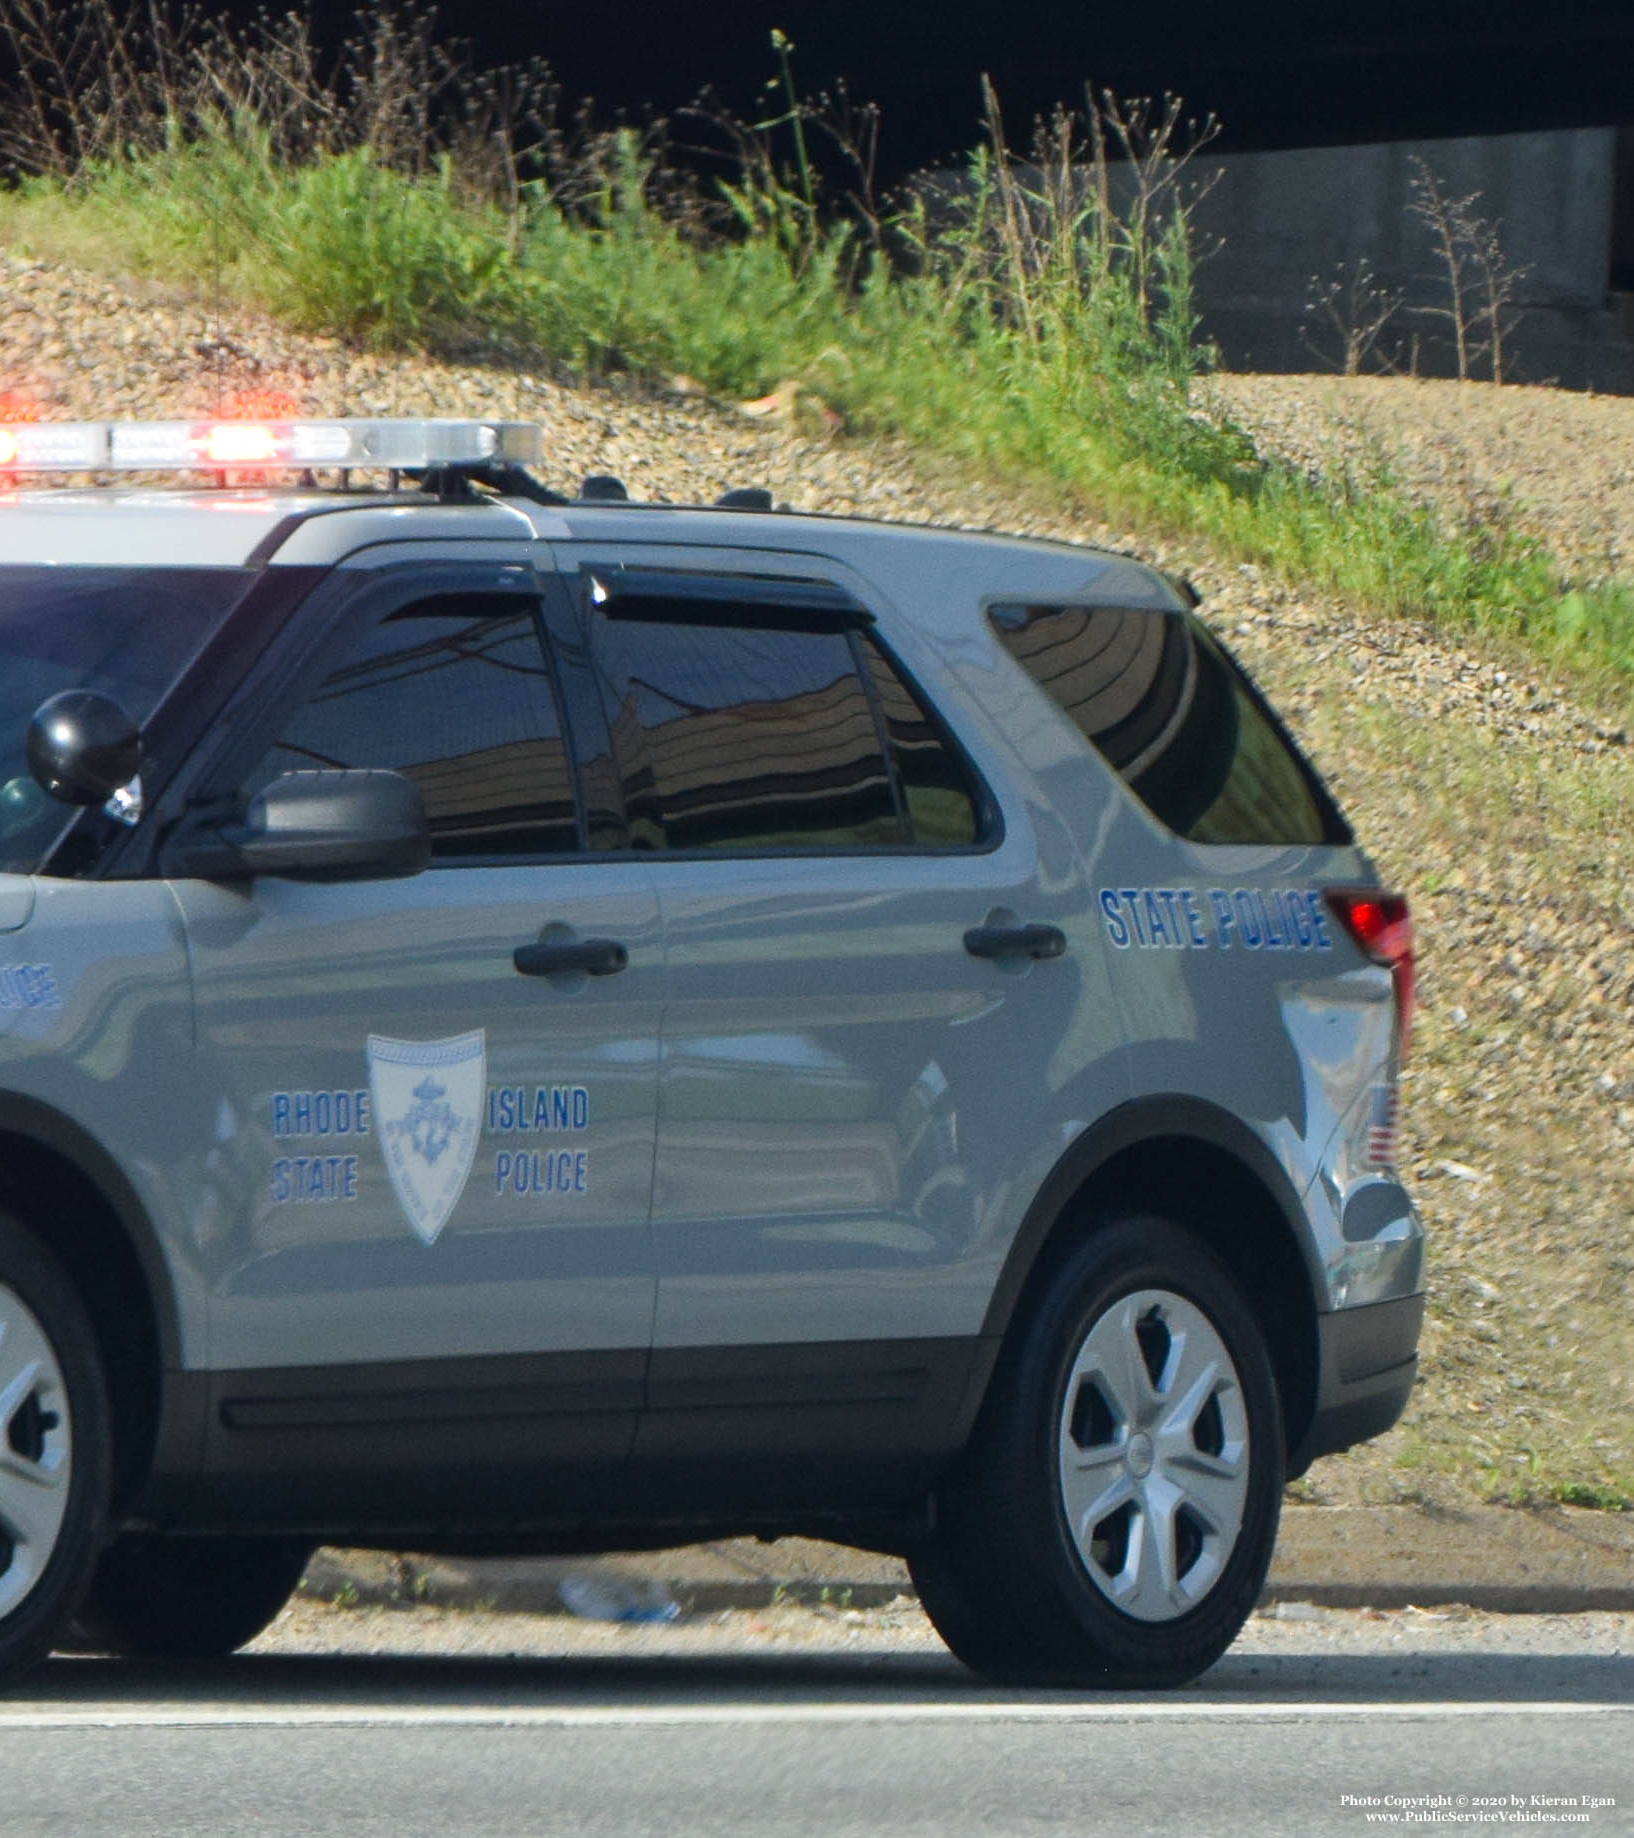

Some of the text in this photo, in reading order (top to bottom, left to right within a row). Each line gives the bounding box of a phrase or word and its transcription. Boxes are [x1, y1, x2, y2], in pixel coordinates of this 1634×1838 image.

[1099, 888, 1333, 950] STATE POLICE
[271, 1086, 590, 1136] RHODE ISLAND
[271, 1150, 588, 1202] STATE POLICE
